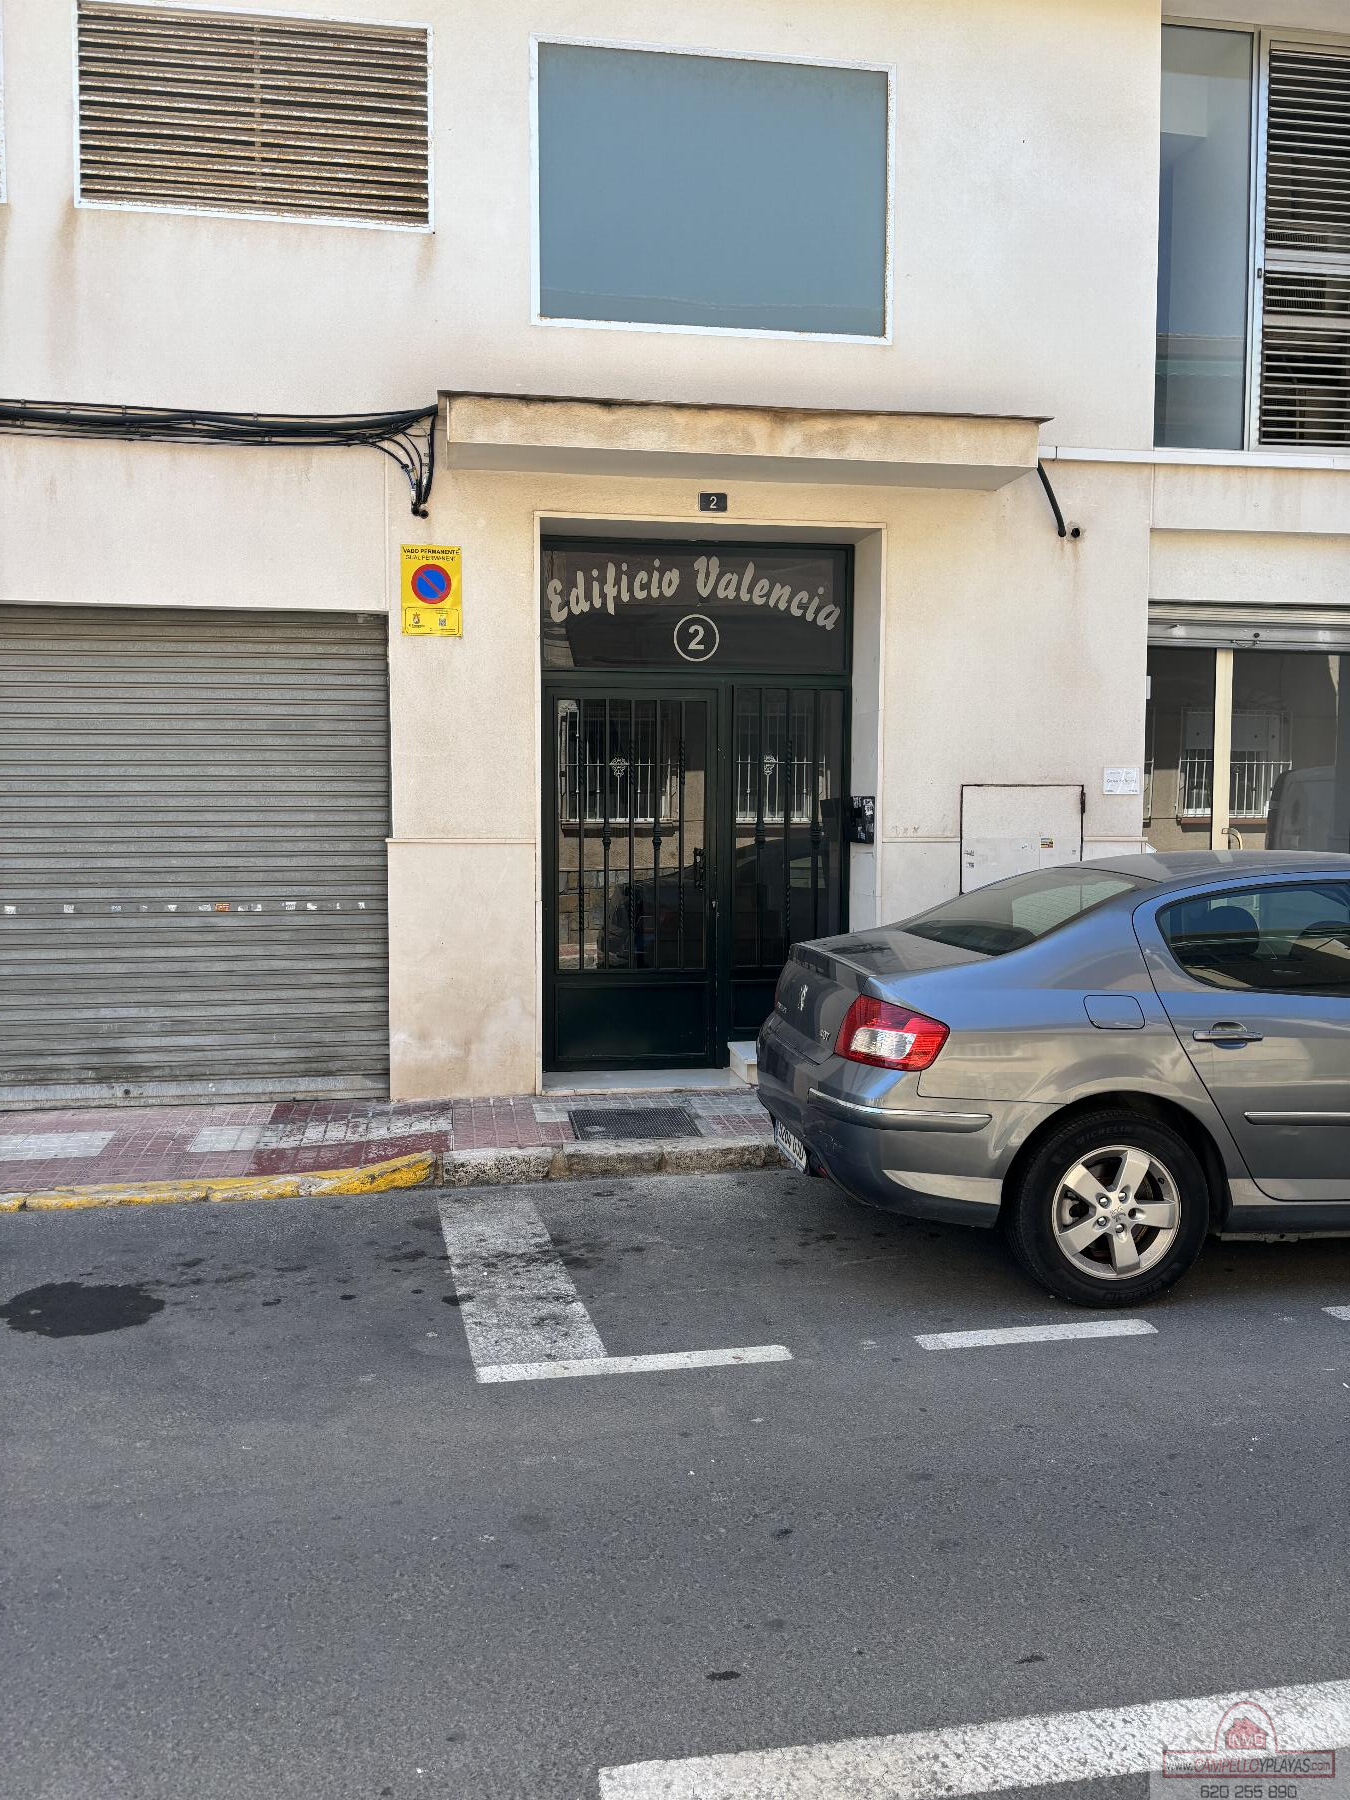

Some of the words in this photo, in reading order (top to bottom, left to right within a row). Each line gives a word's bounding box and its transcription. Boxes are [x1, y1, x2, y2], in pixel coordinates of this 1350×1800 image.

[709, 496, 717, 509] 2
[420, 548, 460, 556] PERMANENTE
[546, 558, 680, 623] Edificio
[693, 555, 841, 631] Valencia
[687, 624, 705, 650] 2
